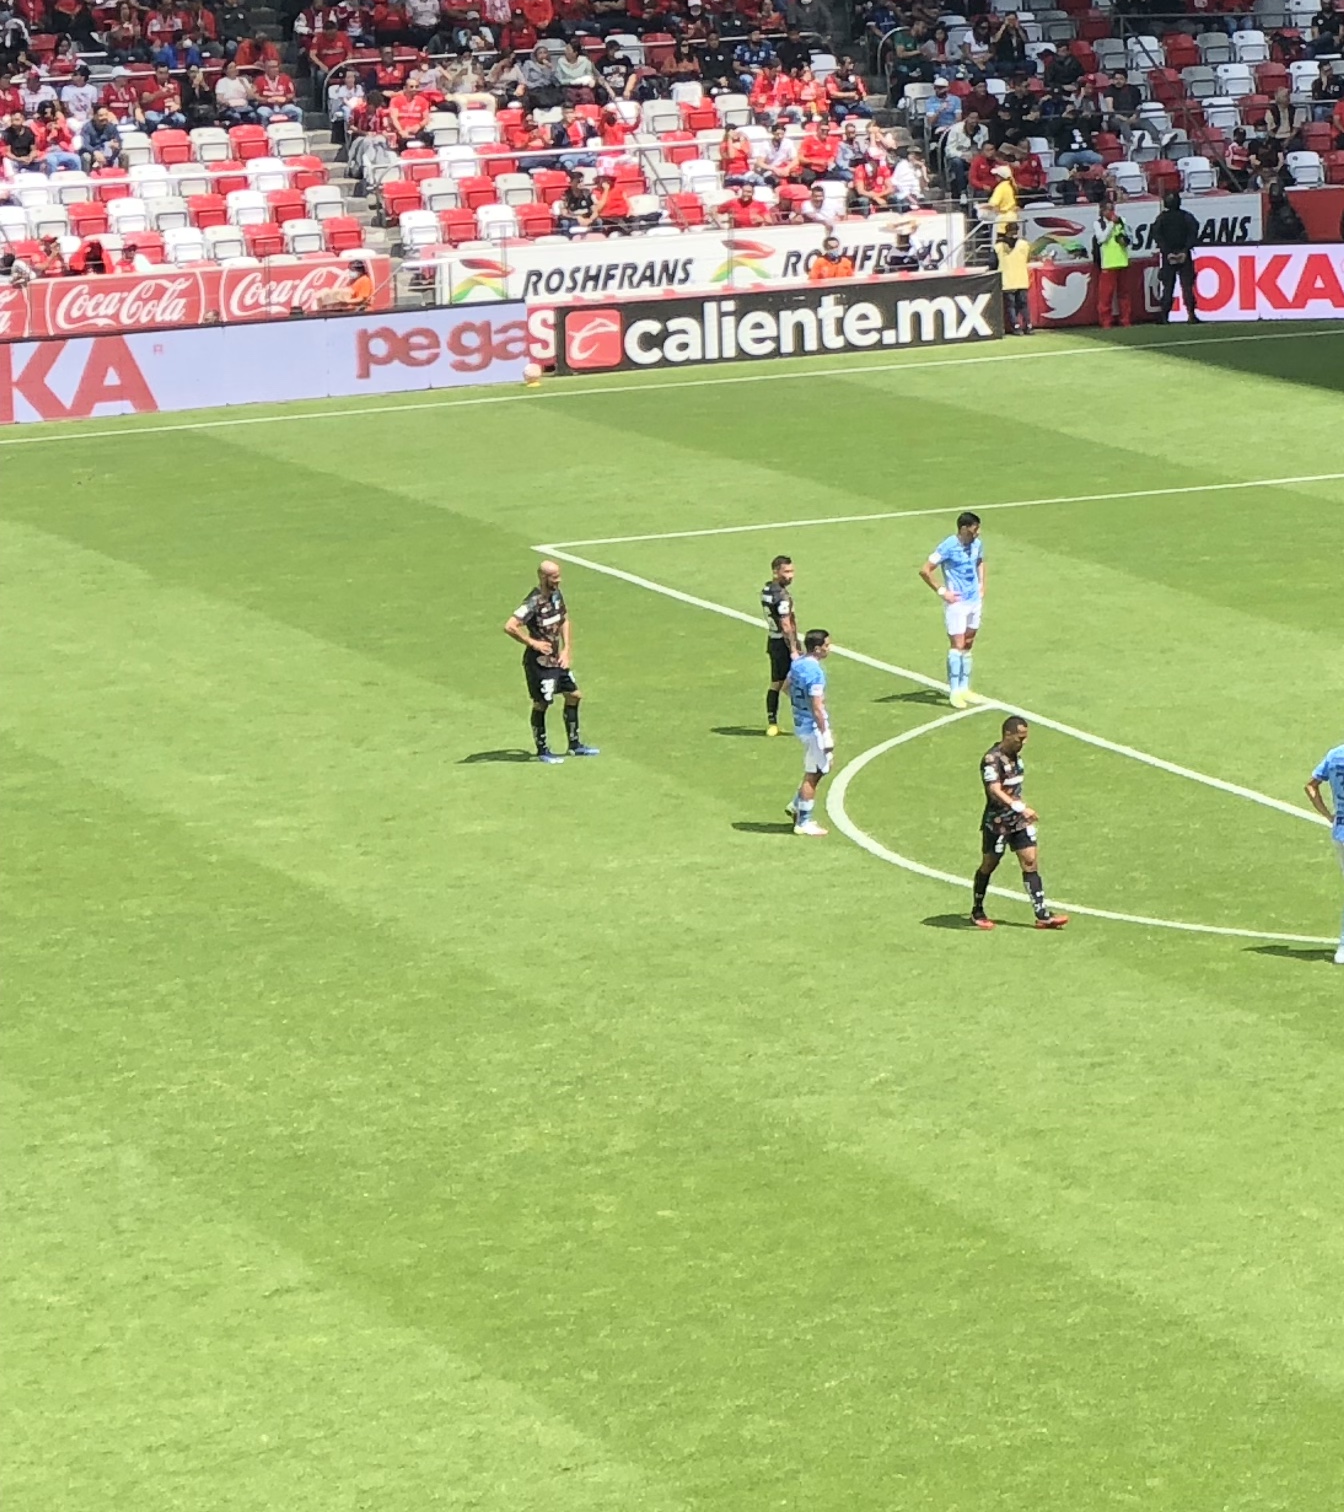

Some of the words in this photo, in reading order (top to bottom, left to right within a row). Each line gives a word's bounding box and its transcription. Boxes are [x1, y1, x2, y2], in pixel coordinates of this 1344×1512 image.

[229, 266, 350, 317] Coca-C
[523, 257, 694, 298] ROSHFRANS
[56, 278, 188, 332] Coca-Cola
[624, 291, 993, 366] caliente.mx
[356, 319, 528, 379] pega
